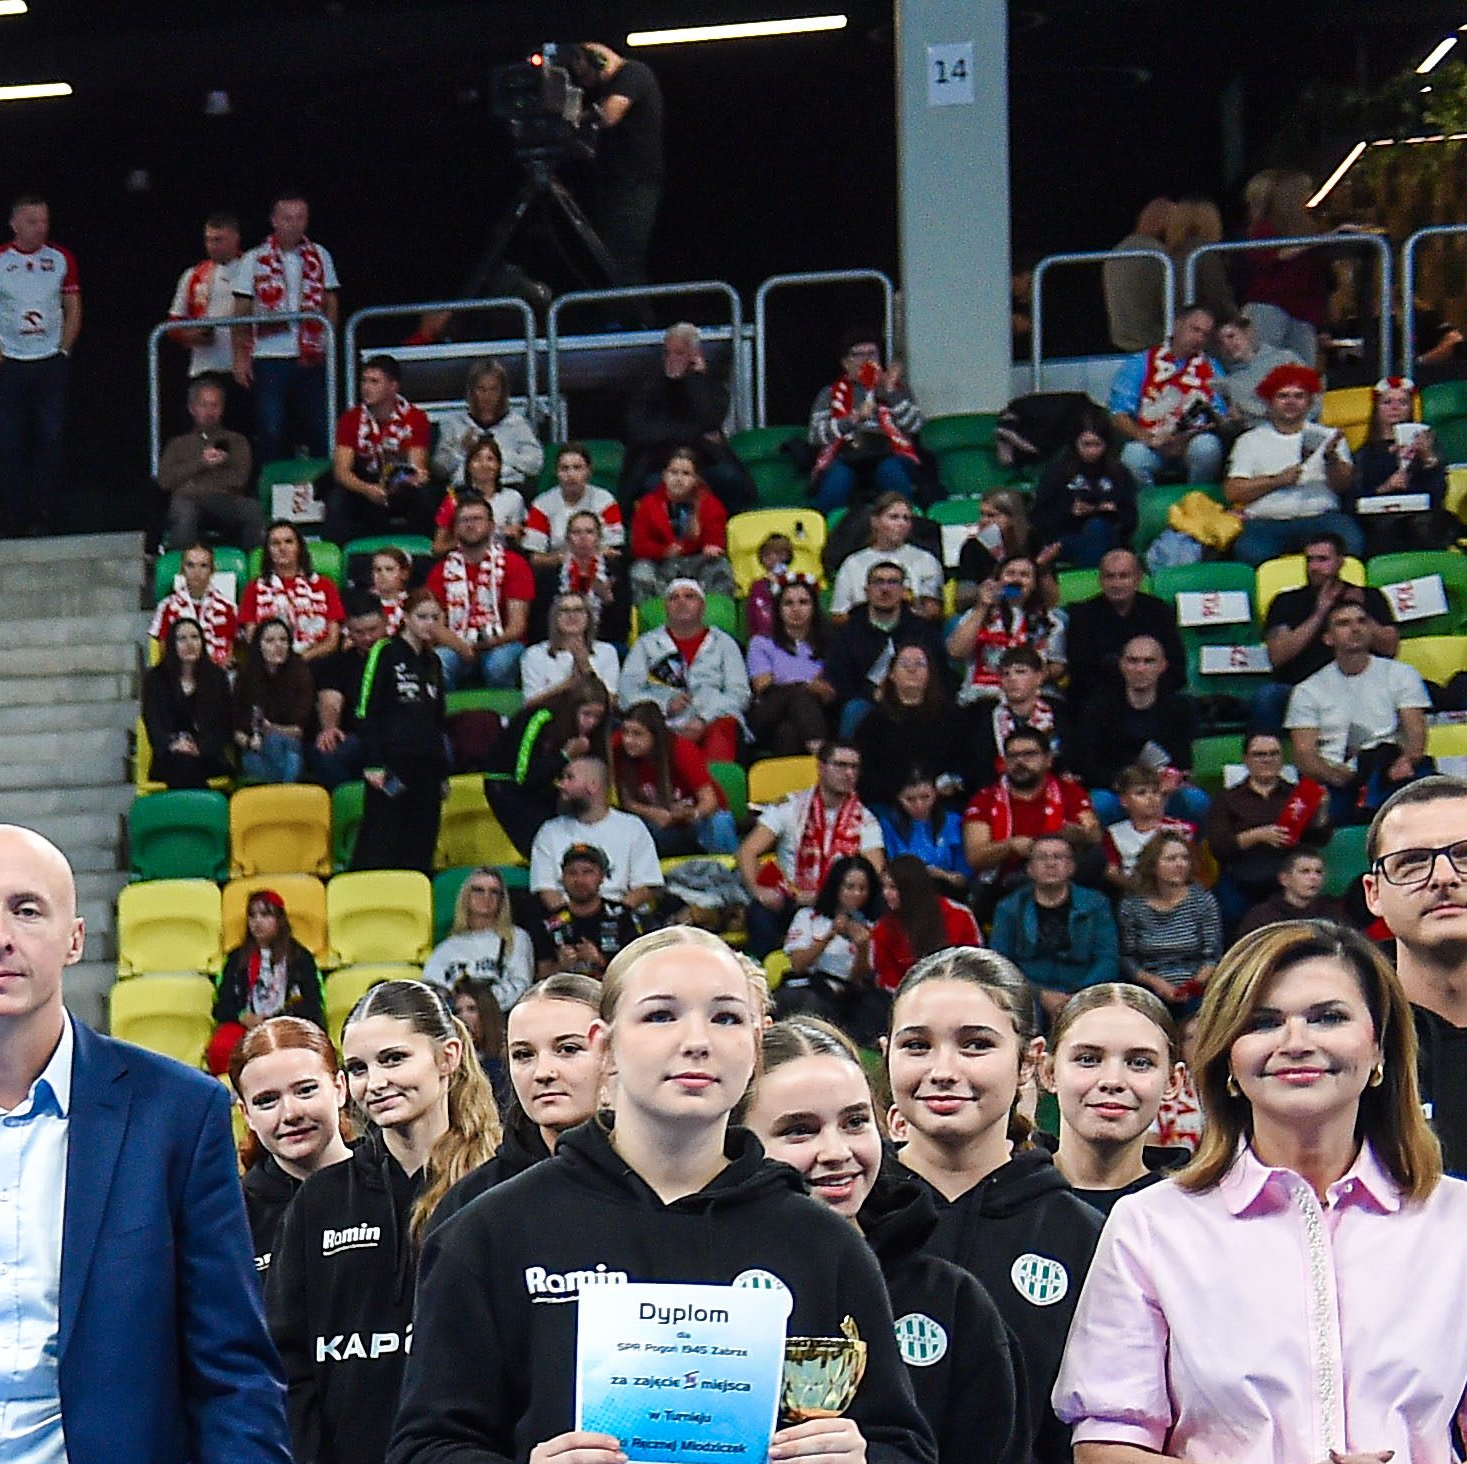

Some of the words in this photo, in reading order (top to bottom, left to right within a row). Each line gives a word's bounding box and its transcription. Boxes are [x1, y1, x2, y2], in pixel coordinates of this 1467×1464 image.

[934, 59, 967, 84] 14
[639, 1302, 729, 1325] Dyplom
[701, 1378, 752, 1393] miejsca
